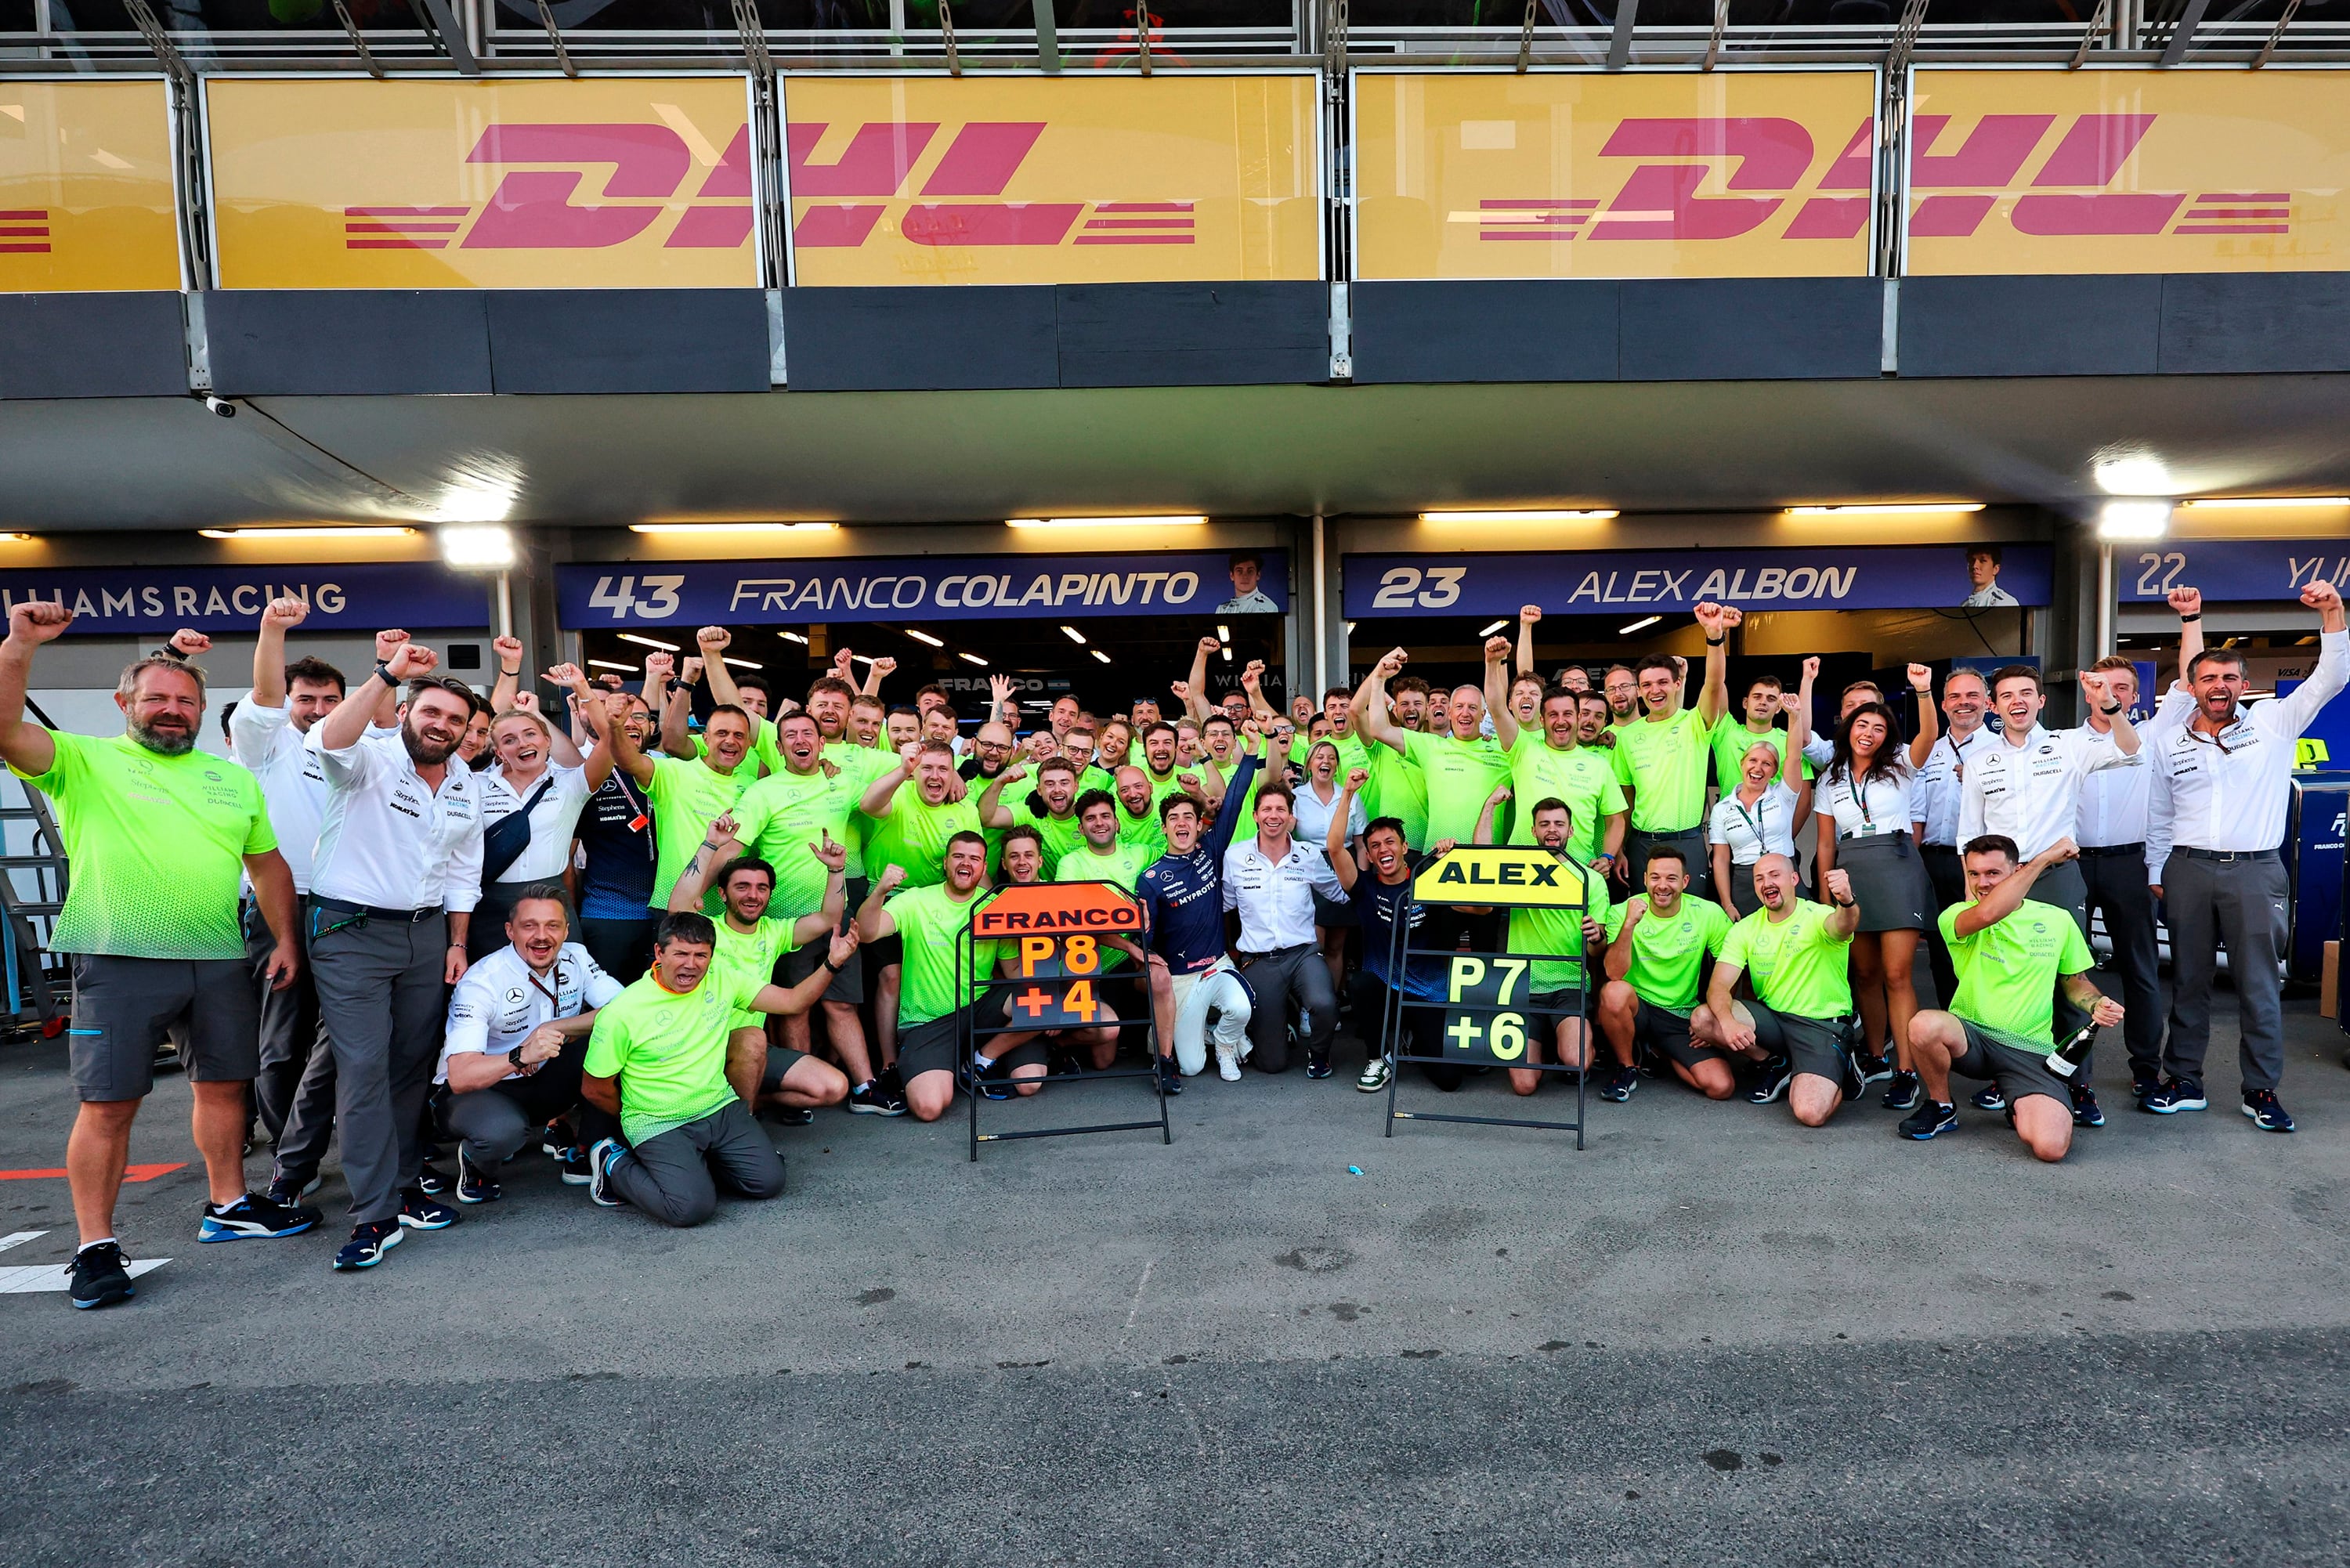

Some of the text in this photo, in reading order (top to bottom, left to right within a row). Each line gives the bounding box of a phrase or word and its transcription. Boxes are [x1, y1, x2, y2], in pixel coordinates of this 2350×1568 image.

[459, 122, 1084, 248] DHL
[1587, 114, 2186, 240] DHL
[729, 571, 1199, 612] FRANCO COLAPINTO
[1372, 567, 1467, 609] 23
[1567, 567, 1857, 604] ALEX ALBON
[2136, 552, 2186, 595] 22
[588, 575, 685, 619] 43
[938, 678, 1043, 691] FRACO
[2278, 668, 2300, 677] VISA
[2032, 756, 2062, 764] WILLIAMS
[389, 802, 420, 818] KOMATSU
[443, 795, 472, 804] WILLIAMS
[446, 811, 472, 820] DURACELL
[1437, 862, 1560, 887] ALEX
[982, 908, 1136, 930] FRANCO
[1021, 934, 1098, 977] P8
[1449, 956, 1528, 1006] P7
